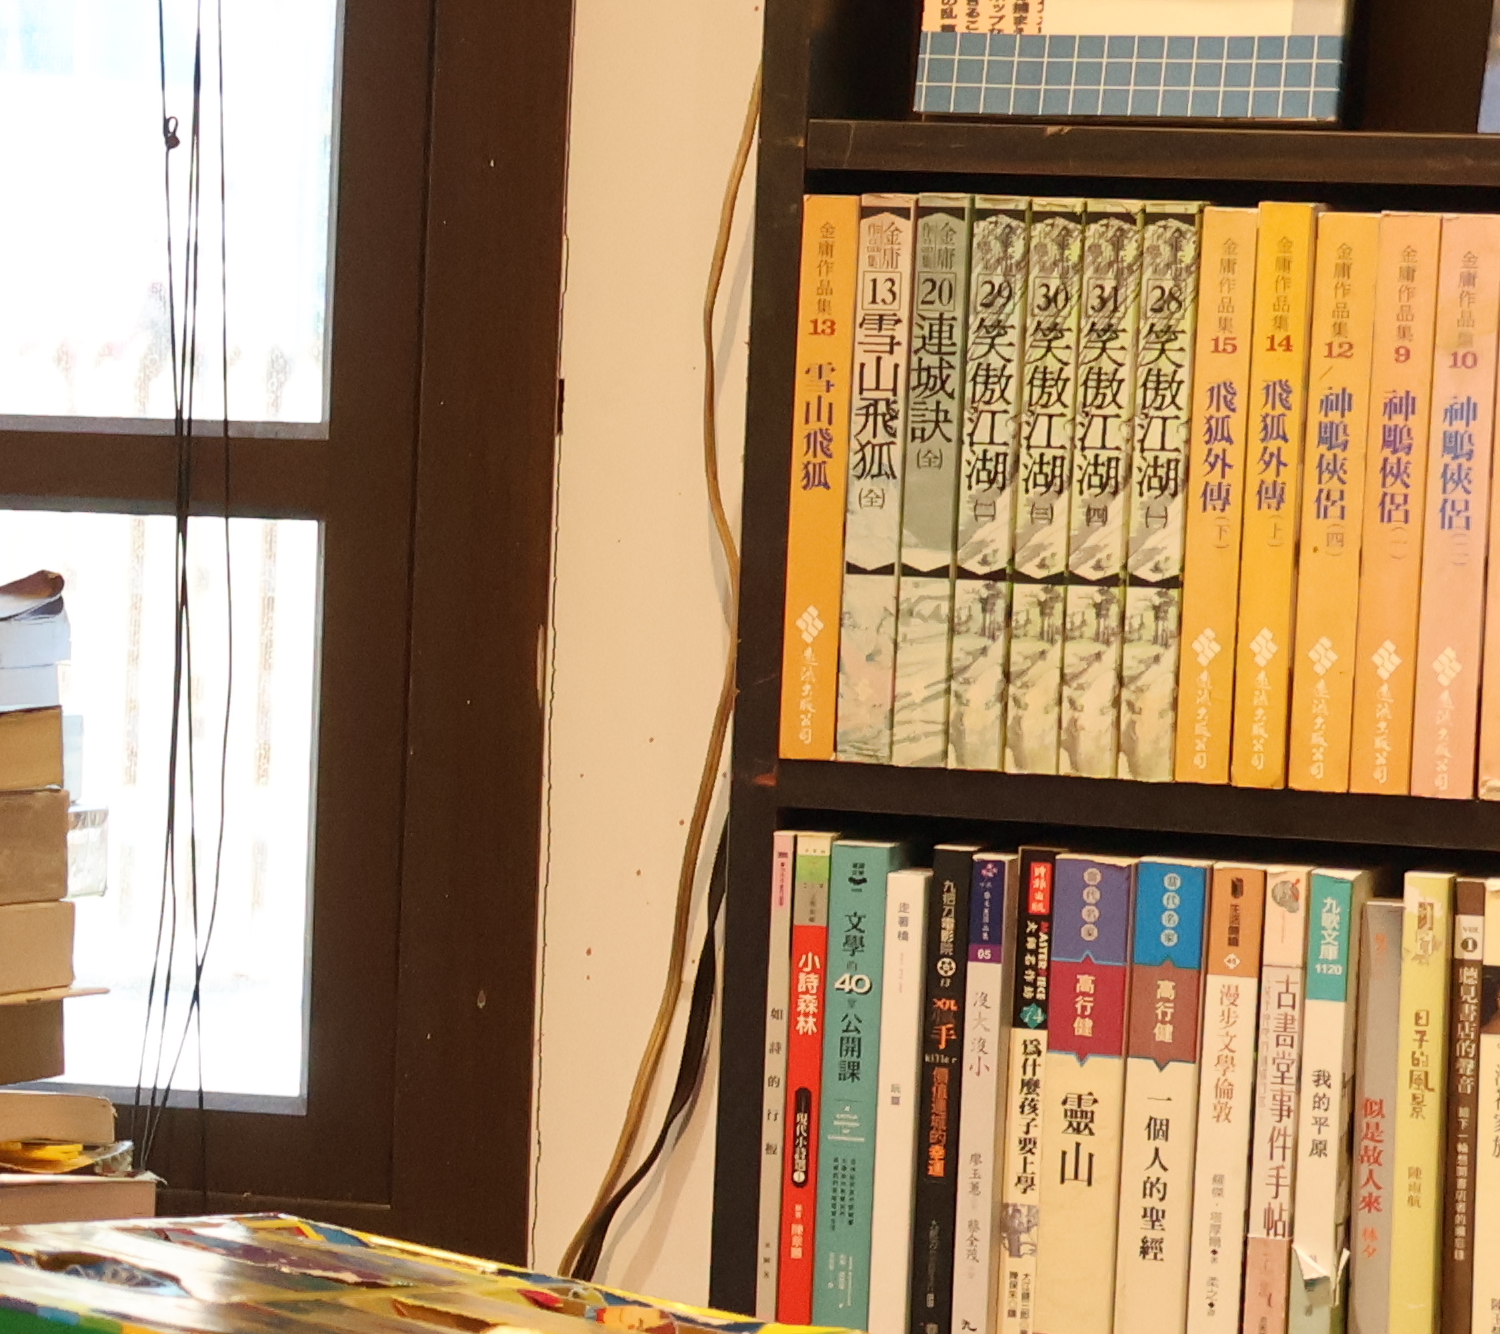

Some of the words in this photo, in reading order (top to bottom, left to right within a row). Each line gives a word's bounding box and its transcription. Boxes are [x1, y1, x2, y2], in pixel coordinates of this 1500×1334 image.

[816, 221, 836, 315] 金庸作品集
[867, 278, 897, 305] 13
[920, 278, 954, 307] 20
[980, 280, 1014, 309] 29
[1036, 283, 1069, 312] 30
[1091, 284, 1121, 312] 31
[1151, 285, 1184, 312] 28
[1217, 237, 1238, 335] 金庸作品集
[1272, 235, 1294, 333] 金庸作品集
[1330, 242, 1353, 339] 金庸作品集
[1395, 244, 1418, 343] 金庸作品集
[808, 319, 837, 337] 13
[1210, 336, 1238, 354] 15
[1265, 334, 1293, 353] 14
[1323, 341, 1354, 359] 12
[1393, 345, 1411, 363] 9
[1448, 351, 1479, 369] 10
[854, 313, 903, 481] 雪山飛狐
[910, 313, 957, 444] 連城訣
[965, 317, 1015, 492] 笑傲江湖
[1022, 320, 1073, 497] 笑傲江湖
[1076, 320, 1127, 498] 笑傲江湖
[1136, 322, 1187, 499] 笑傲江湖
[801, 363, 836, 491] 雪山飛狐
[1200, 379, 1238, 513] 飛狐外傳
[1255, 379, 1293, 511] 飛狐外傳
[1314, 386, 1353, 521] 神鵰俠侶
[1377, 389, 1418, 525] 神鵰俠侶
[1439, 395, 1478, 531] 神鵰俠侶
[1315, 964, 1342, 975] 1120
[1319, 897, 1340, 961] 九歌文庫
[796, 951, 820, 1035] 小詩森林
[1073, 975, 1096, 1037] 高行健
[1154, 980, 1176, 1043] 高行健
[1212, 984, 1240, 1124] 漫步文學倫敦
[1060, 1092, 1098, 1187] 靈山
[1263, 975, 1299, 1238] 古書堂事件手帖
[1308, 1070, 1332, 1157] 我的平原
[1139, 1095, 1172, 1261] 一個人的聖經
[1358, 1099, 1385, 1213] 似是故人來
